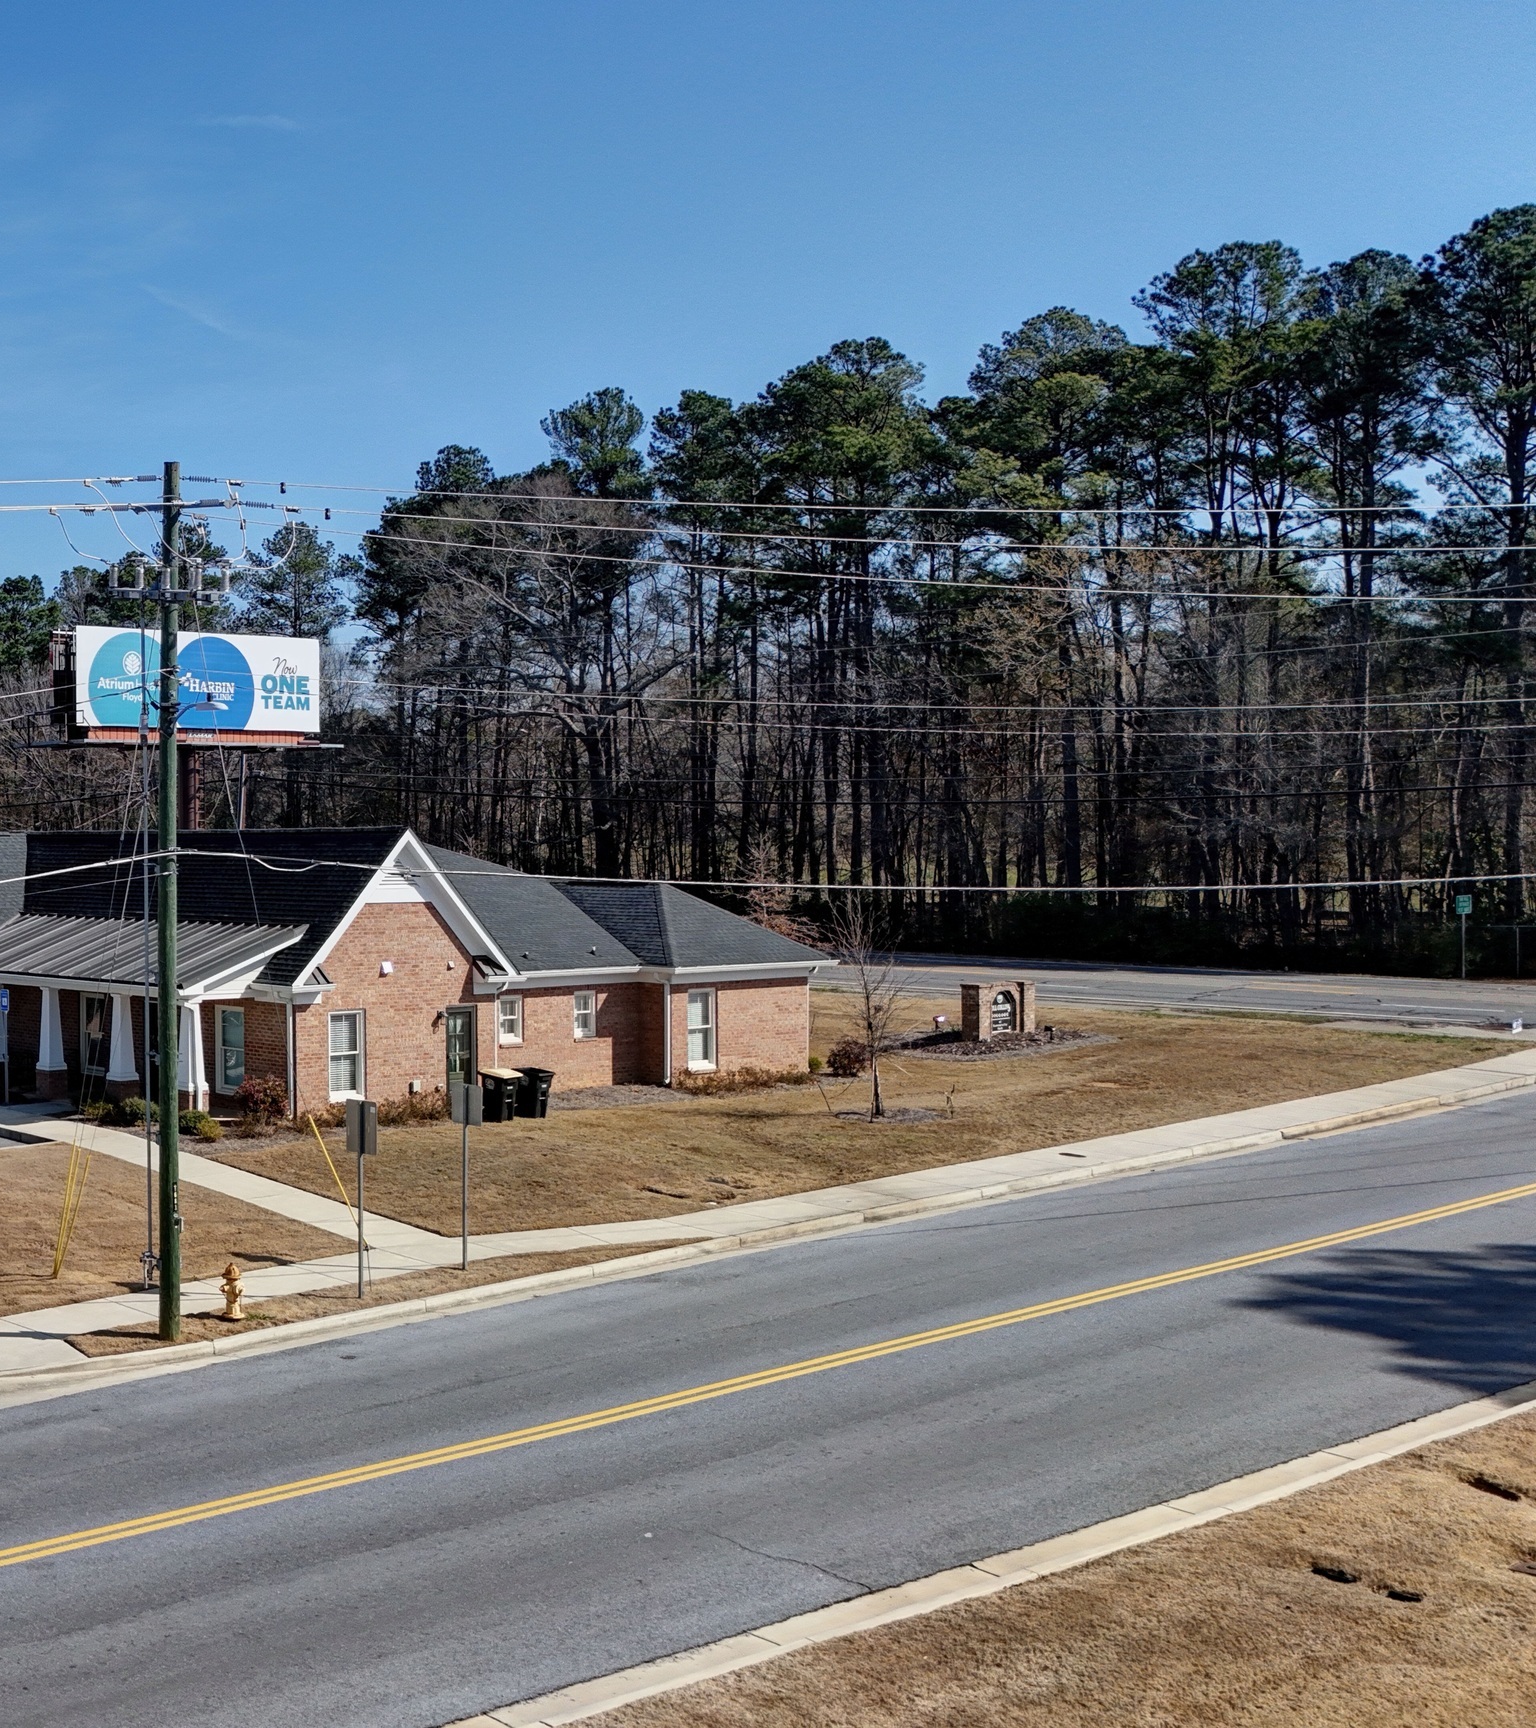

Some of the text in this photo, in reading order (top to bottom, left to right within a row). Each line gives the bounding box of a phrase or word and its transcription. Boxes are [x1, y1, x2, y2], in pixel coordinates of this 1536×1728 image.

[273, 656, 298, 676] Now
[97, 677, 134, 690] Atrium
[189, 678, 235, 693] HARBIN
[261, 674, 310, 695] ONE
[122, 693, 143, 703] Floyd
[261, 695, 310, 711] TEAM
